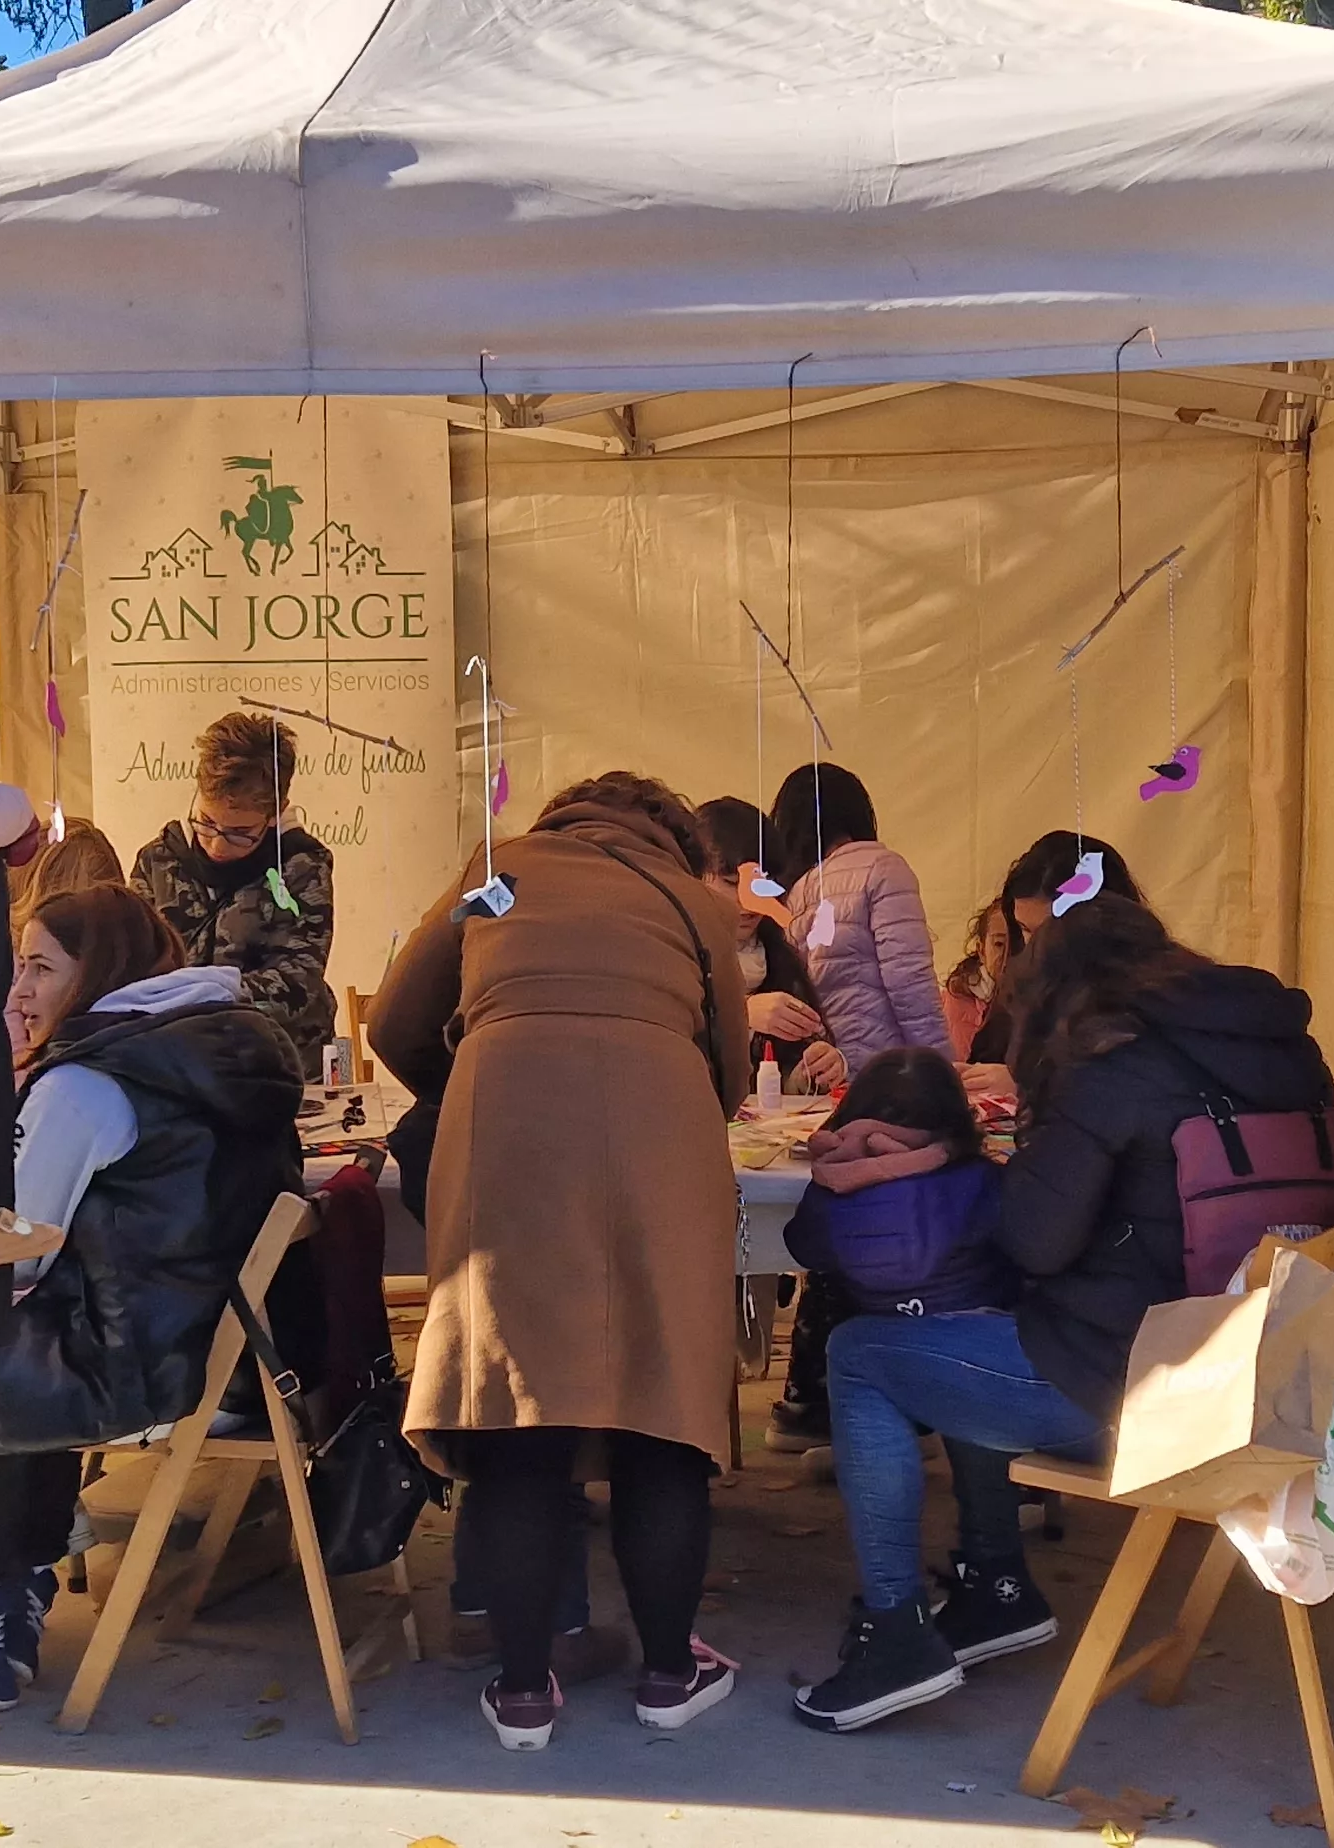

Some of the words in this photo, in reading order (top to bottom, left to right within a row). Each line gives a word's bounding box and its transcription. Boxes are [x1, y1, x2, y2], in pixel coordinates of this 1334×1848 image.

[110, 595, 222, 643] SAN
[242, 593, 429, 653] JORGE
[111, 674, 303, 695] Administraciones
[310, 675, 322, 697] y
[329, 670, 430, 692] Servicios
[324, 735, 352, 776] de
[362, 739, 426, 794] fincas
